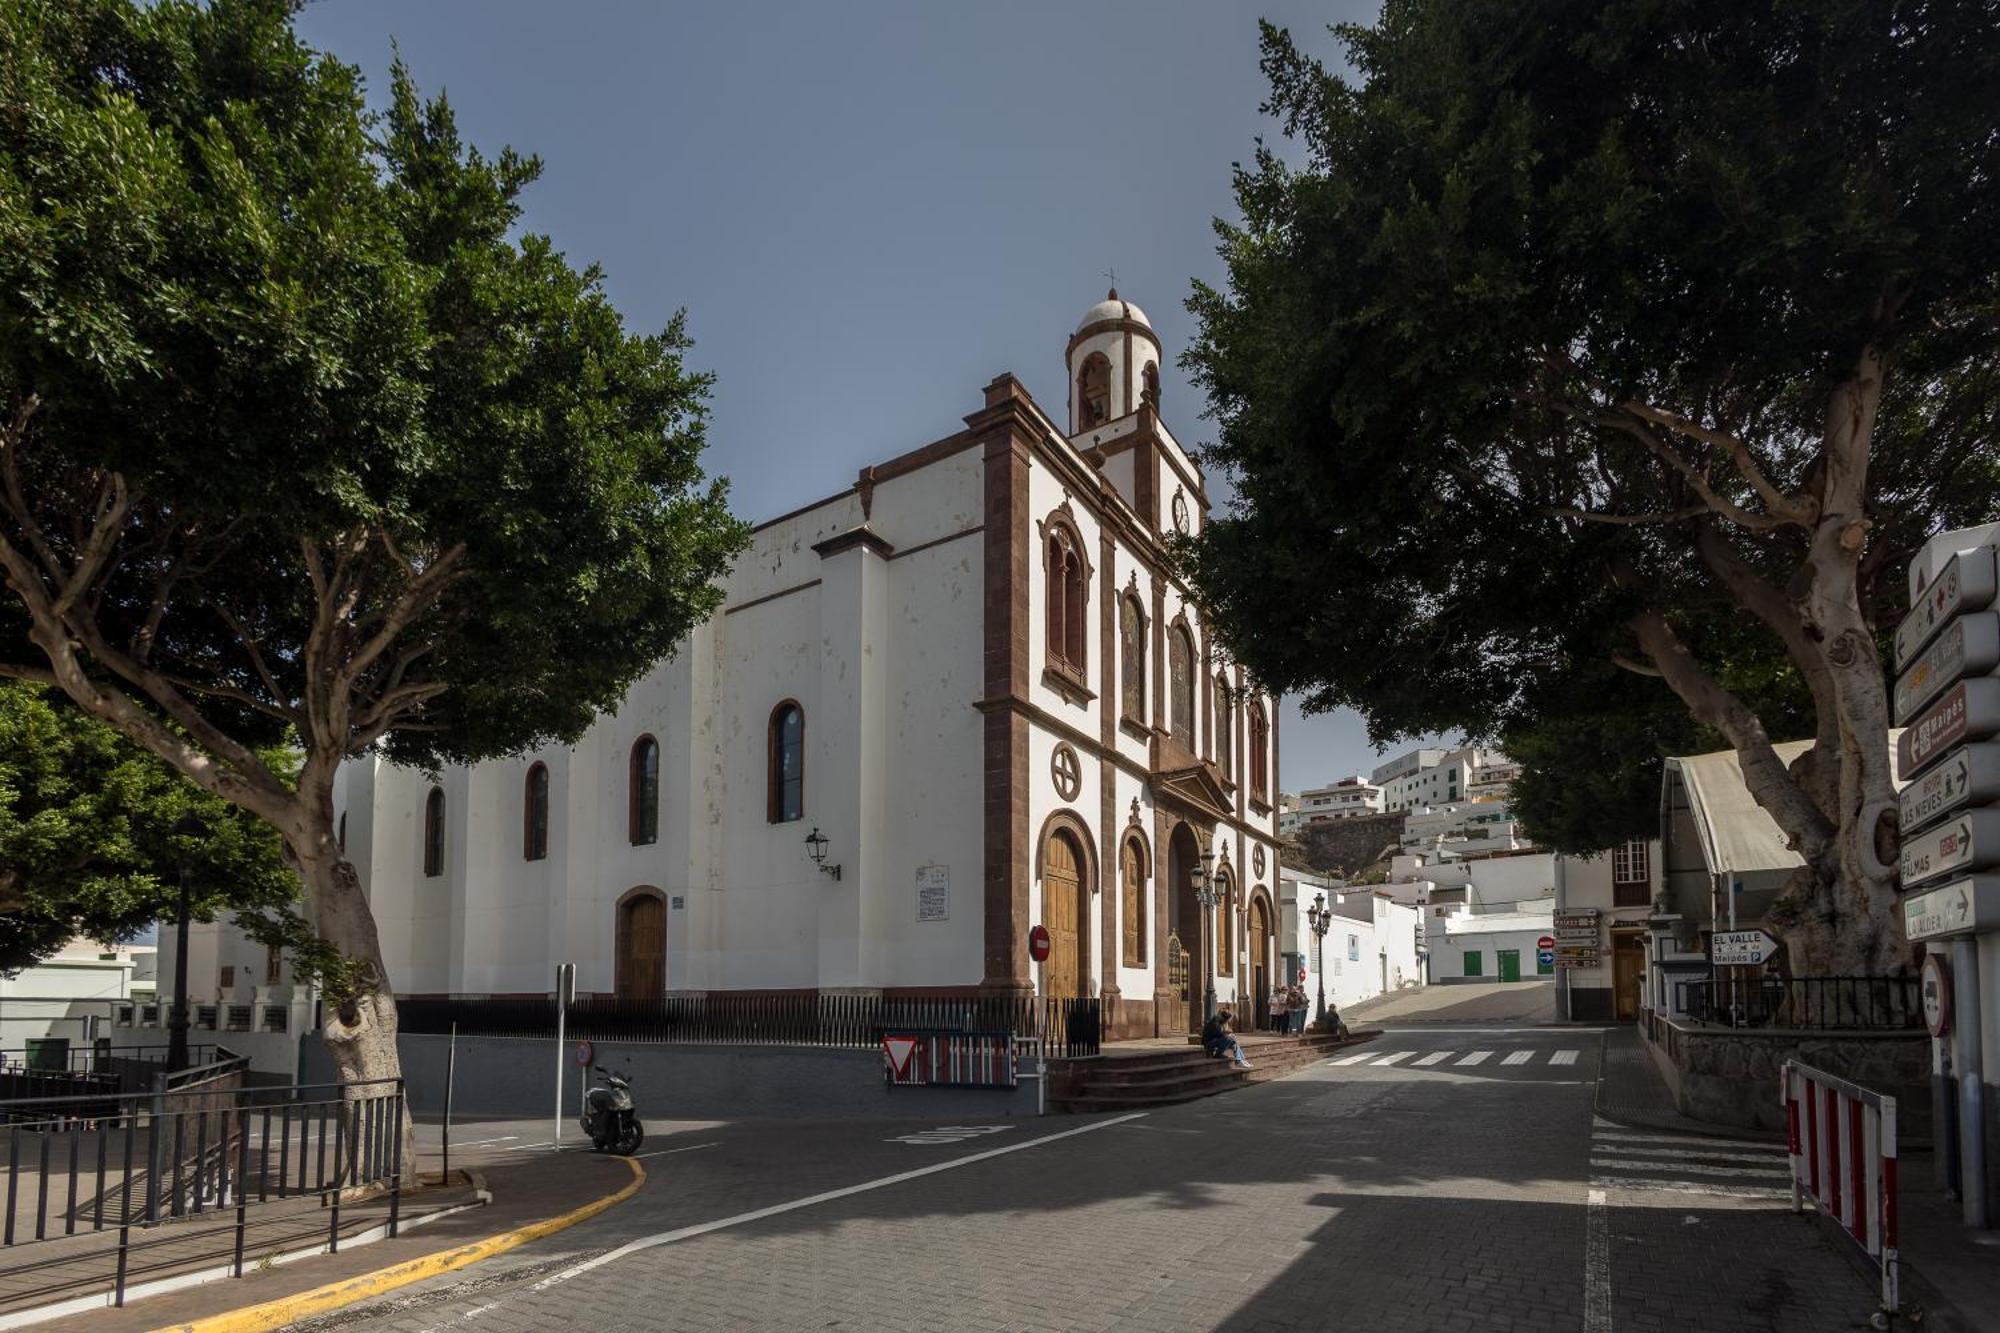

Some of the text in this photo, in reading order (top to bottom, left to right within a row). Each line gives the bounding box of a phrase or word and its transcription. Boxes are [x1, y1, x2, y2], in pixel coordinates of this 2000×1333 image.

[1915, 791, 1942, 820] NIEVES
[1902, 855, 1931, 879] PALMAS
[1714, 933, 1761, 945] EL VALLE
